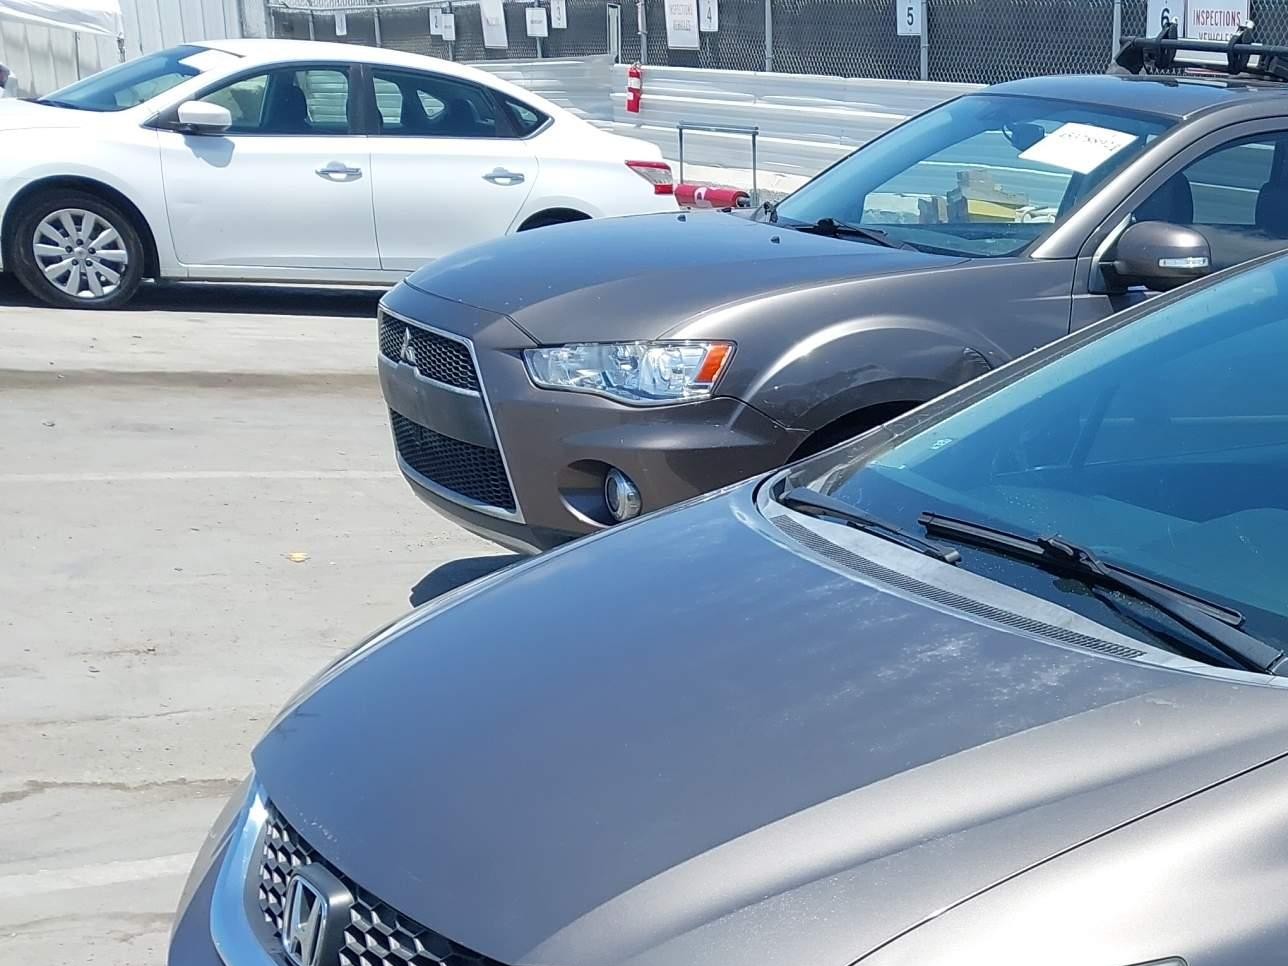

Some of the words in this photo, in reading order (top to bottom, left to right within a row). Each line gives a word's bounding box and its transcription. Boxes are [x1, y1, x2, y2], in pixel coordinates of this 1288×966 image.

[706, 6, 713, 24] 4
[906, 7, 914, 26] 5
[1160, 7, 1171, 28] 6
[1193, 9, 1241, 27] INSPECTIONS
